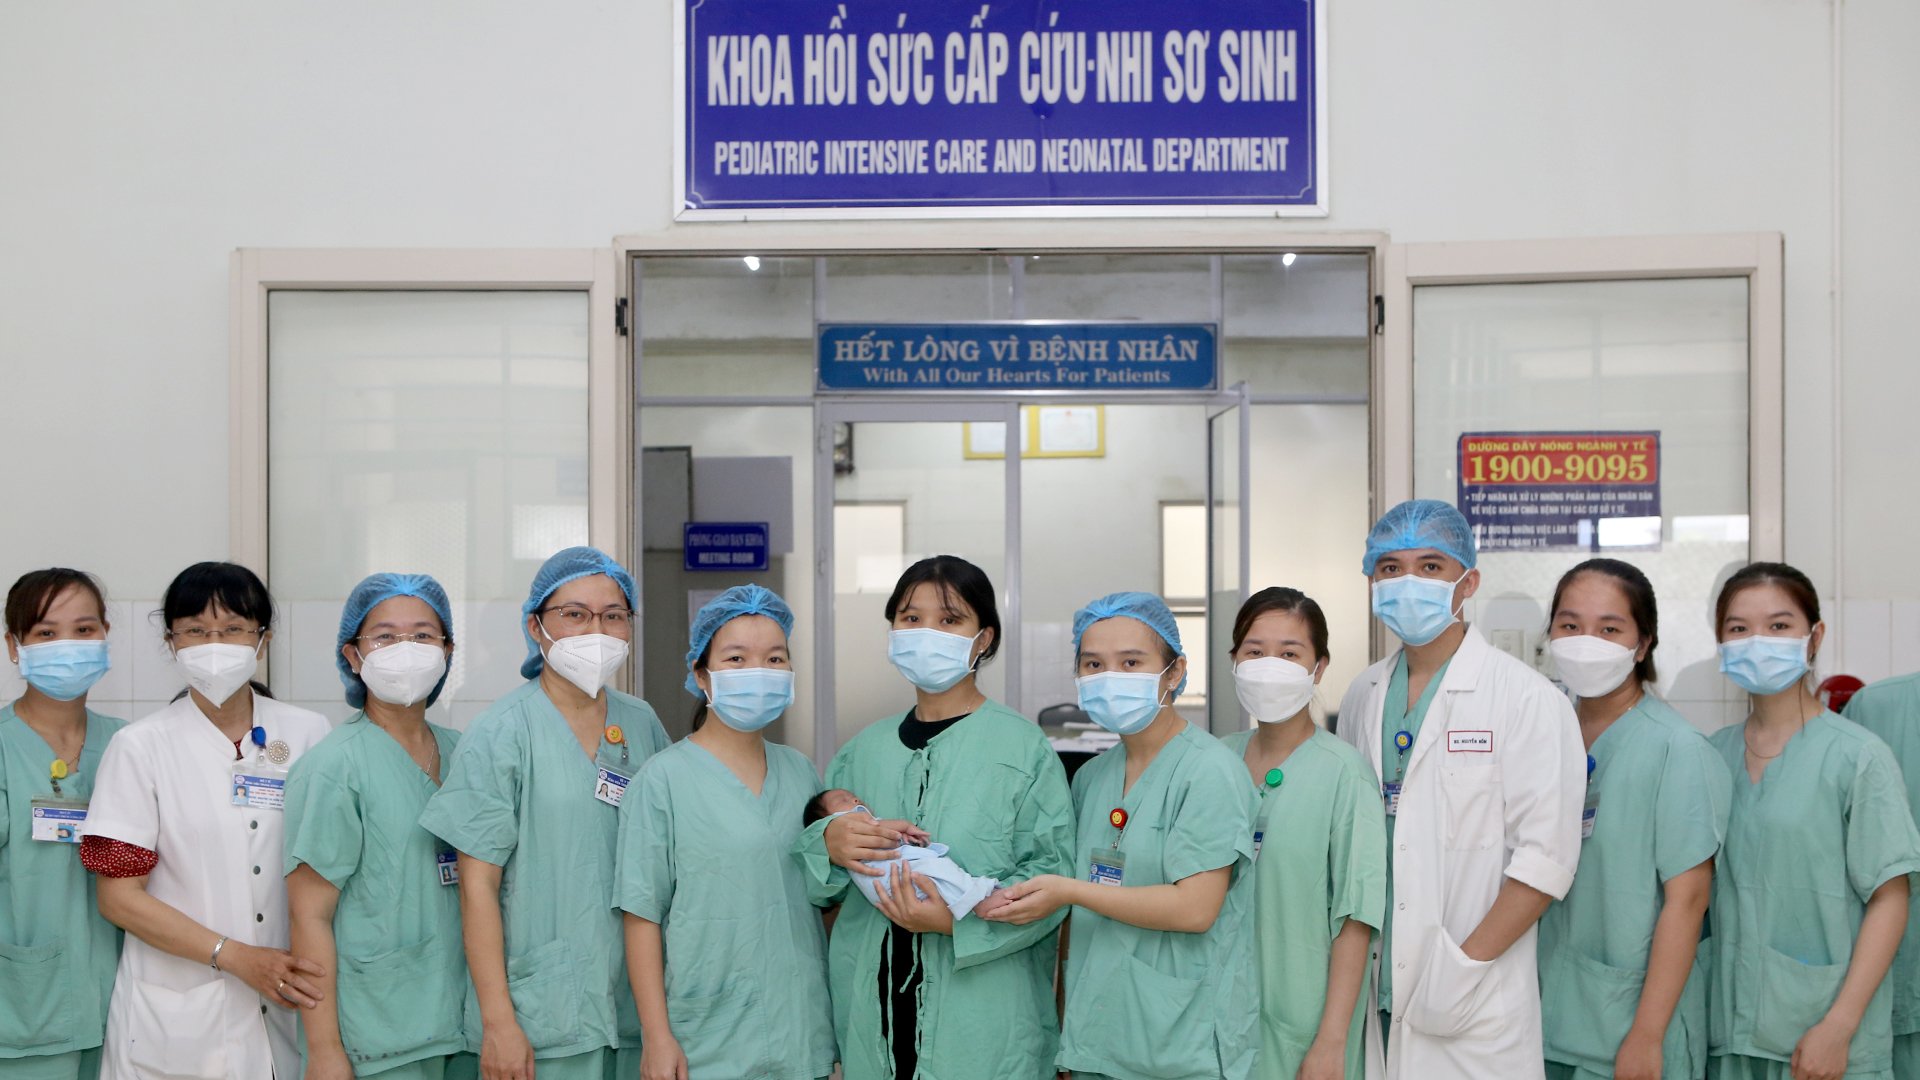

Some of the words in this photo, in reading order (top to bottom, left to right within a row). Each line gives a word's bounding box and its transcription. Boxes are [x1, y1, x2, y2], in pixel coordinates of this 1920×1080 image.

[707, 33, 795, 107] KHOA
[803, 4, 858, 106] HỒI
[867, 13, 934, 106] SỨC
[944, 4, 1009, 105] CẤP
[1163, 29, 1210, 103] SƠ
[1218, 29, 1297, 103] SINH
[714, 140, 819, 176] PEDIATRIC
[824, 139, 929, 175] INTENSIVE
[934, 139, 988, 175] CARE
[993, 138, 1036, 174] AND
[1042, 138, 1148, 173] NEONATAL
[1153, 137, 1289, 172] DEPARTMENT
[834, 330, 895, 362] HẾT
[903, 335, 981, 362] LÒNG
[989, 334, 1019, 361] VÌ
[1028, 334, 1109, 366] BỆNH
[1118, 334, 1199, 361] NHÂN
[863, 367, 908, 384] With
[913, 367, 940, 384] All
[945, 367, 982, 384] Our
[987, 367, 1051, 384] Hearts
[1056, 367, 1088, 383] For
[1094, 367, 1171, 383] Patients
[1621, 441, 1629, 451] Y
[1632, 438, 1648, 451] TẾ
[1470, 454, 1648, 482] 1900-9095
